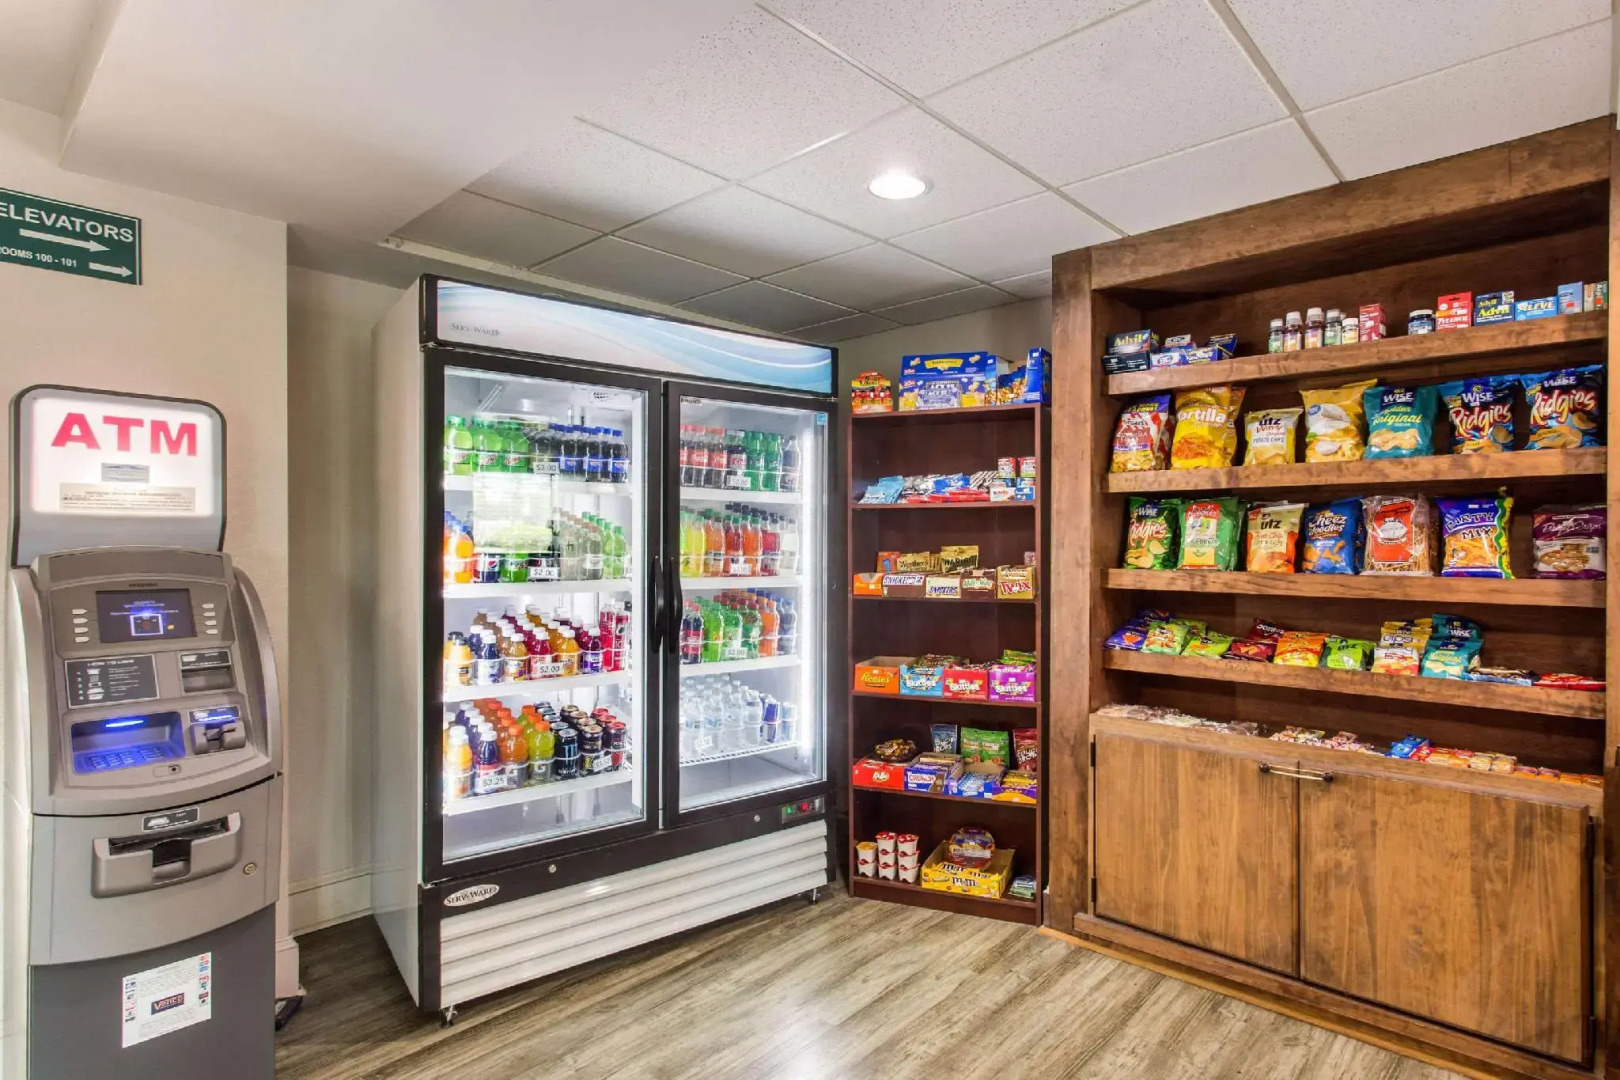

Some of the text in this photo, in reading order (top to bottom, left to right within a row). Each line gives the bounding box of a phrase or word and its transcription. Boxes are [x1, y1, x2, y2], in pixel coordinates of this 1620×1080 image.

[0, 202, 134, 243] ELEVATORS
[0, 246, 33, 260] OOMS
[35, 253, 53, 263] 100
[61, 258, 77, 268] 101
[1479, 306, 1510, 317] Advil
[1113, 334, 1143, 347] Advil
[1383, 391, 1415, 403] WISE
[1461, 391, 1495, 404] WISE
[1530, 389, 1597, 426] Ridgies
[1450, 403, 1512, 438] Ridgies
[51, 412, 197, 457] ATM
[536, 464, 557, 472] $2.00
[1138, 507, 1158, 517] WISE
[1461, 526, 1493, 540] MIX
[540, 665, 560, 674] $2.00
[482, 778, 505, 787] $2.25
[908, 774, 935, 783] CRUNCH
